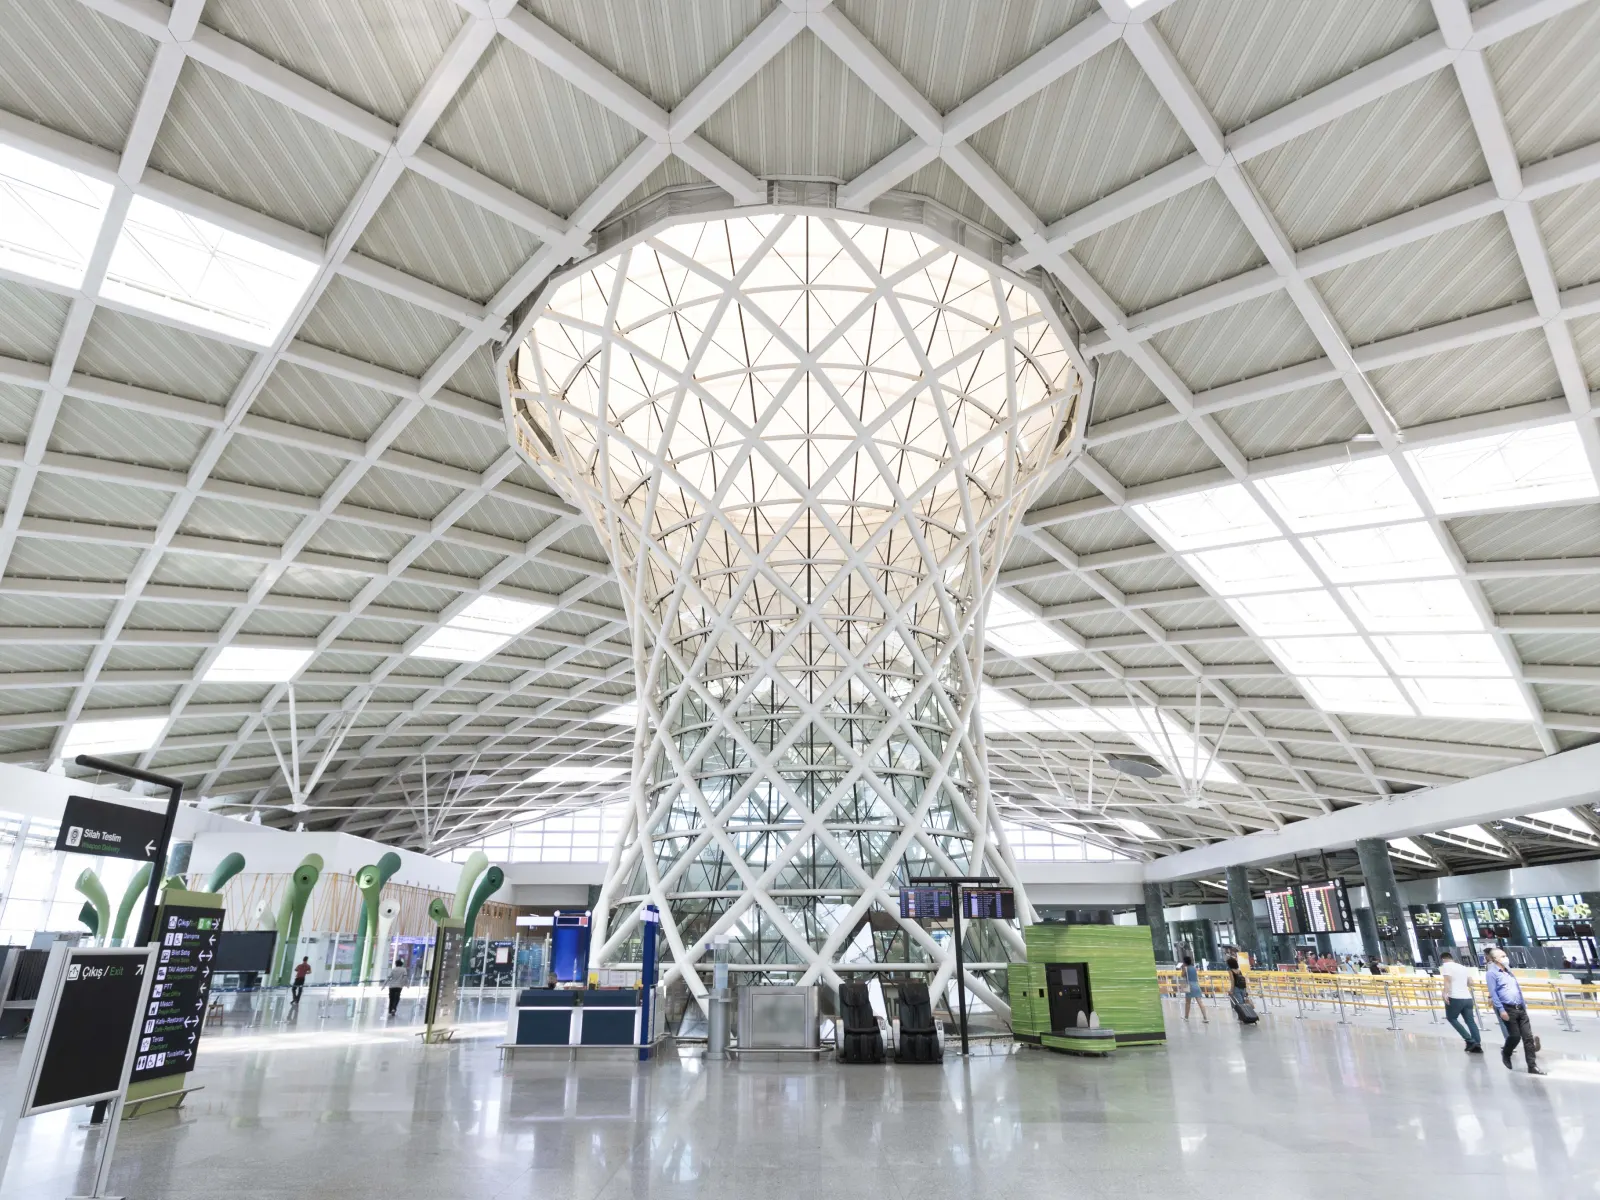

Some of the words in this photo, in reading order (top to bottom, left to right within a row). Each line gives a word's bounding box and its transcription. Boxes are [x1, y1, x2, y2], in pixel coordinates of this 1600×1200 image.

[83, 828, 101, 839] Silah
[102, 831, 122, 843] Teslim
[82, 966, 103, 980] Çıkış
[110, 967, 124, 976] Exit
